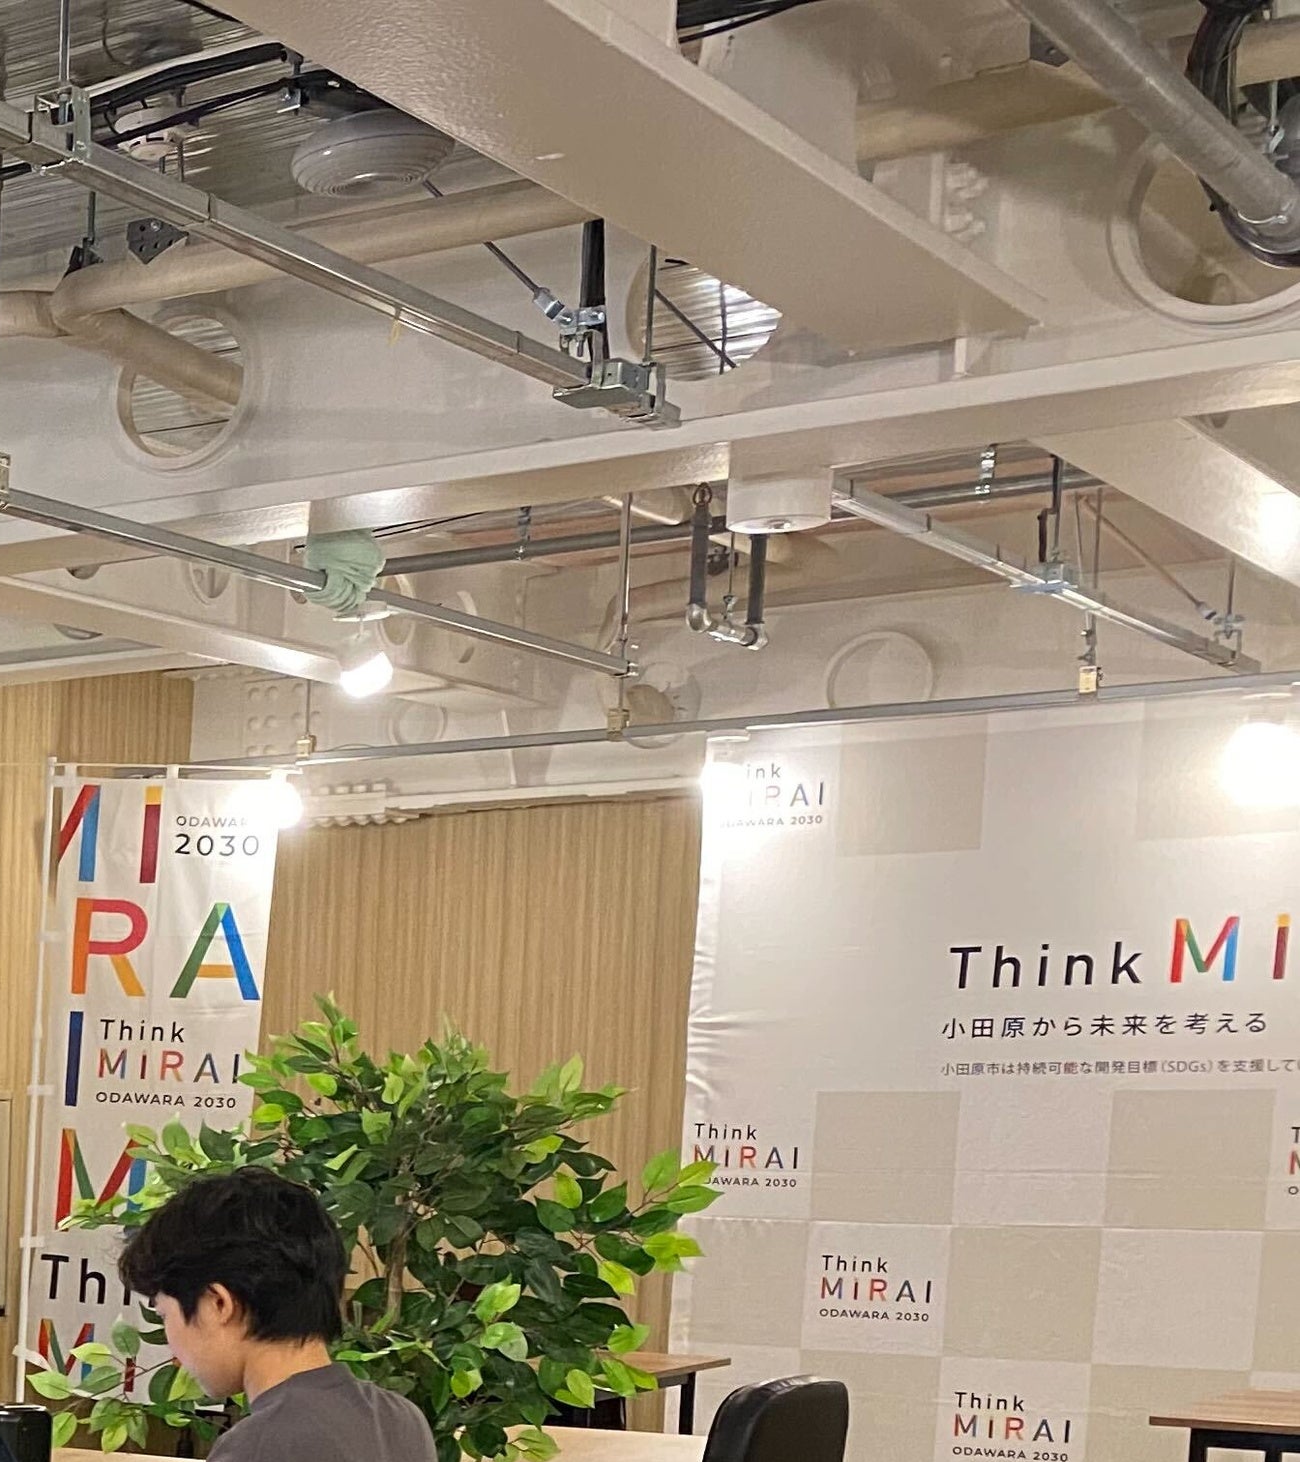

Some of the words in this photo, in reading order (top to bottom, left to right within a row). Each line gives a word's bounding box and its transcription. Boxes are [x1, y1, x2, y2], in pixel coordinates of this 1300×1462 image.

[746, 762, 782, 779] ink
[790, 814, 823, 825] 2030
[174, 833, 259, 856] 2030
[71, 897, 260, 1001] RA
[950, 941, 1143, 989] Think
[100, 1019, 185, 1044] Think
[941, 1013, 1267, 1039] 小田原から未来を考える
[96, 1091, 185, 1107] ODAWARA
[194, 1096, 236, 1109] 2030
[694, 1123, 757, 1140] Think
[705, 1177, 759, 1186] AWARA
[765, 1179, 797, 1188] 2030
[822, 1255, 888, 1273] Think
[819, 1308, 889, 1320] ODAWARA
[896, 1312, 929, 1322] 2030
[954, 1392, 1024, 1411] Think
[952, 1446, 1026, 1459] ODAWARA
[1032, 1452, 1068, 1462] 2030
